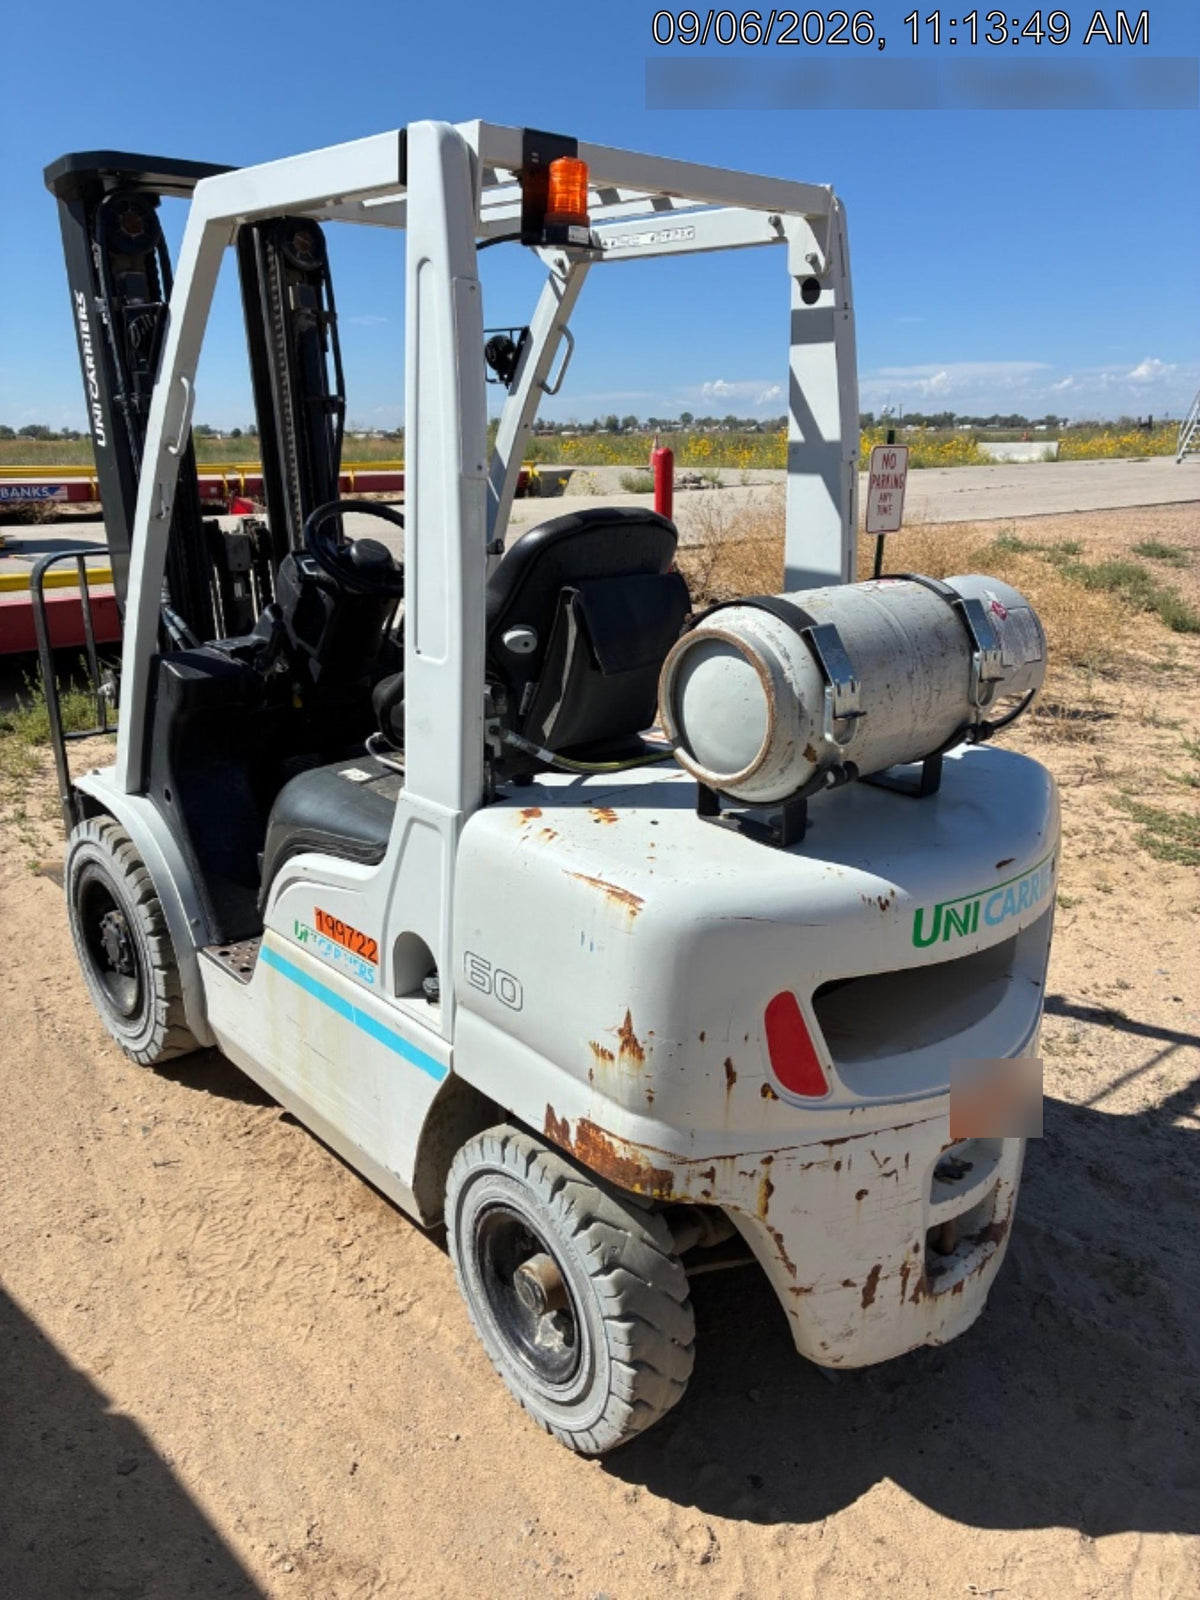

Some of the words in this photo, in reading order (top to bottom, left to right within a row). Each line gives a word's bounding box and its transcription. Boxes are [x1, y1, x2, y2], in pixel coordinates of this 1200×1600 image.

[881, 452, 897, 470] NO
[872, 473, 905, 490] PARKING
[315, 909, 379, 966] 199722
[463, 950, 524, 1012] 60
